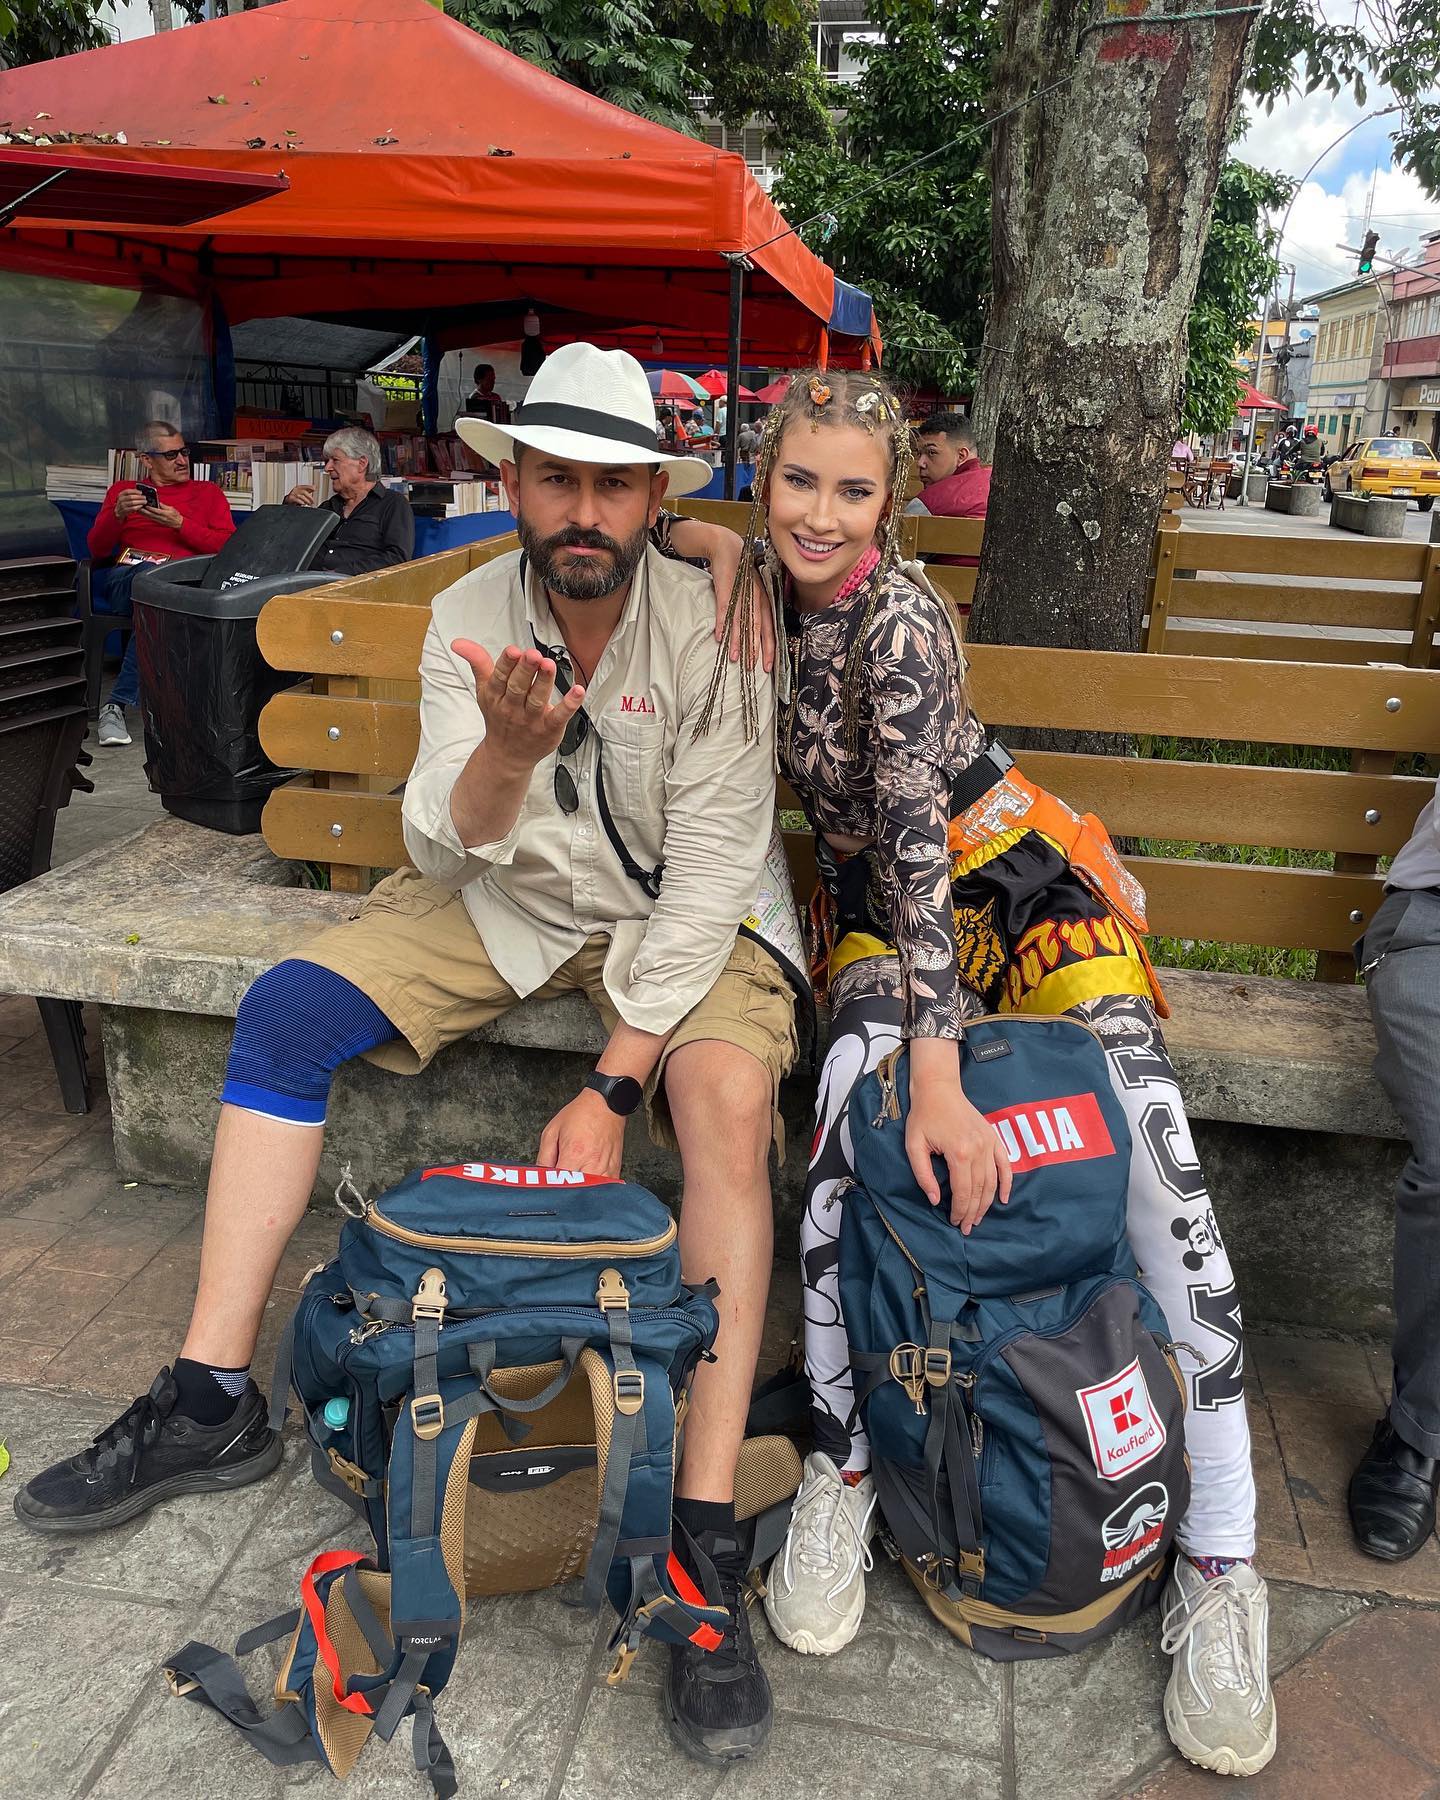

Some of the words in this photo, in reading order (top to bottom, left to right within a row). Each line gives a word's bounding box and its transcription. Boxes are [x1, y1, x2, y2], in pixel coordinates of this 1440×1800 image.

[980, 1045, 1005, 1056] FORCLAZ
[992, 1107, 1085, 1163] ULIA
[463, 1163, 586, 1185] MIKE
[1106, 1424, 1156, 1462] Kaufland
[1100, 1538, 1160, 1583] express
